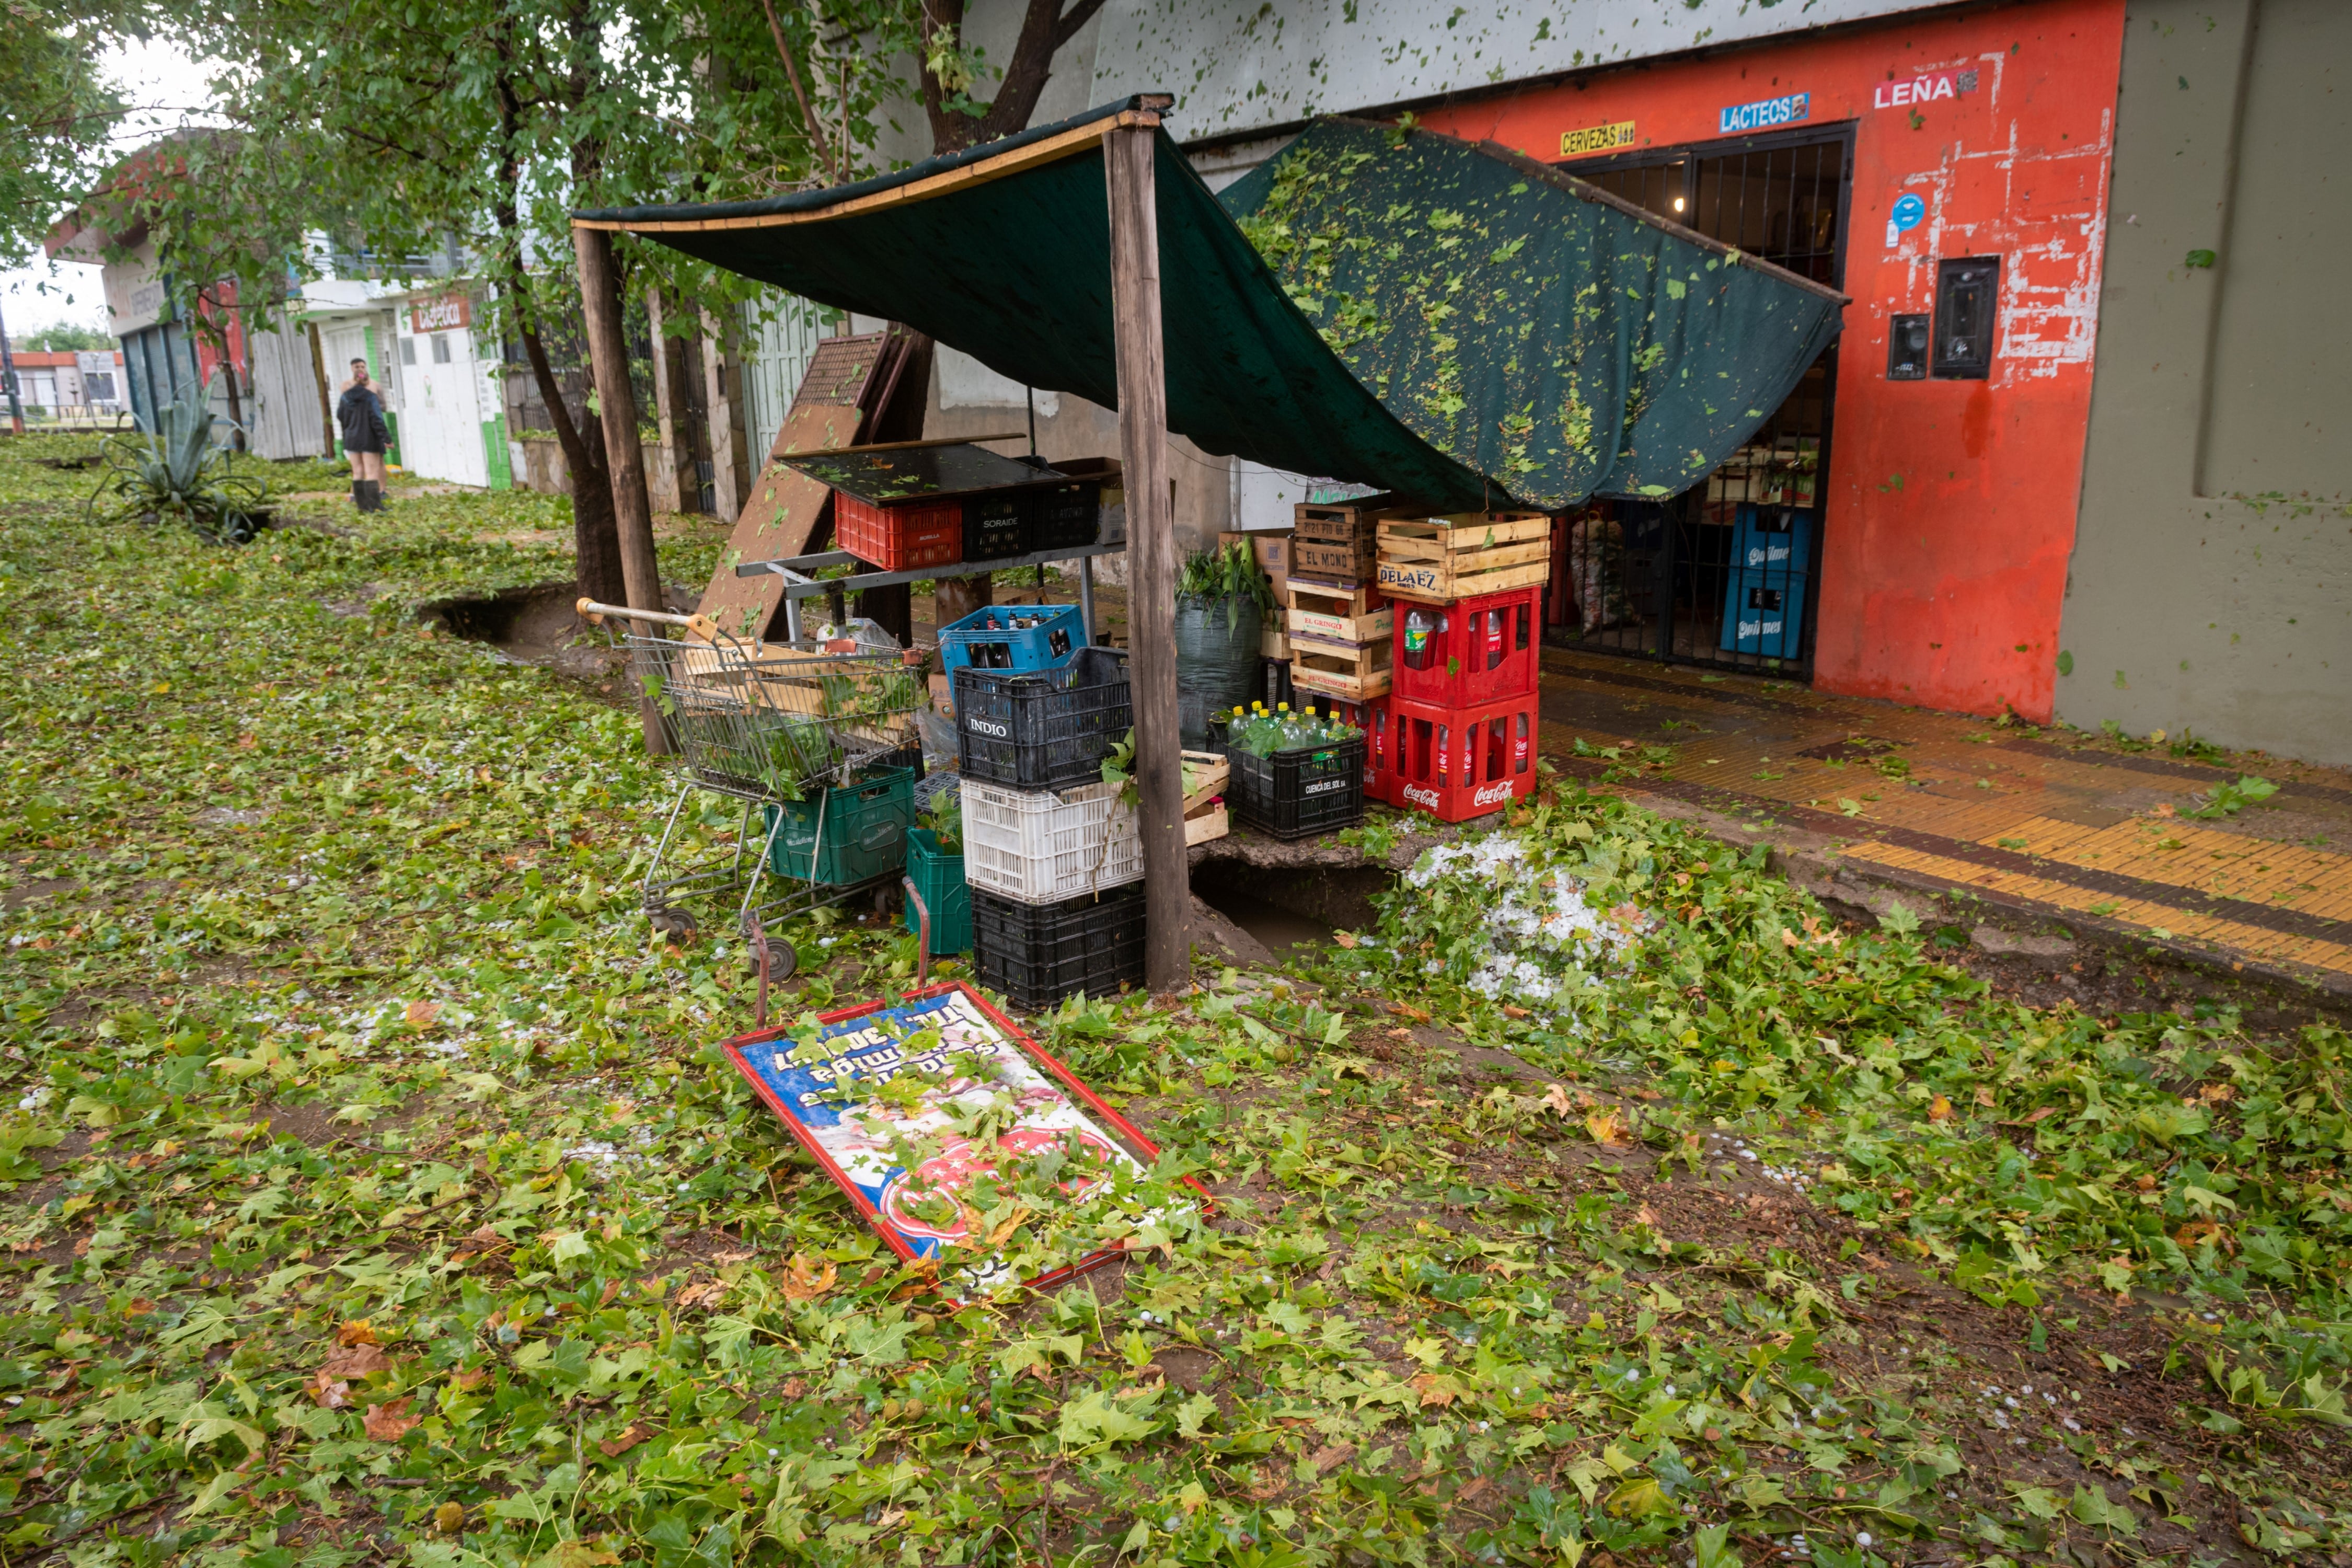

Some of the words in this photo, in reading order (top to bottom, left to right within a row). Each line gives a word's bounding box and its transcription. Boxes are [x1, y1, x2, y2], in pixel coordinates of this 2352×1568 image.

[1874, 75, 1954, 109] LEÑA
[1721, 97, 1790, 132] LACTEOS
[1562, 125, 1616, 155] CERVEZAS
[983, 517, 1019, 528] SORAIDE
[1307, 551, 1318, 566] EL
[1321, 552, 1347, 568] MONO
[1748, 545, 1792, 566] Quilme
[1380, 569, 1436, 591] PELAEZ
[1314, 619, 1342, 630] GRINGO
[1318, 677, 1347, 689] GRINGO
[970, 718, 1007, 737] INDIO
[1306, 782, 1323, 794] CUENCA
[1323, 782, 1332, 790] DEL
[1332, 780, 1340, 789] SOL
[1403, 783, 1441, 808] Coca-Cola
[1474, 779, 1515, 807] Coca-Cola
